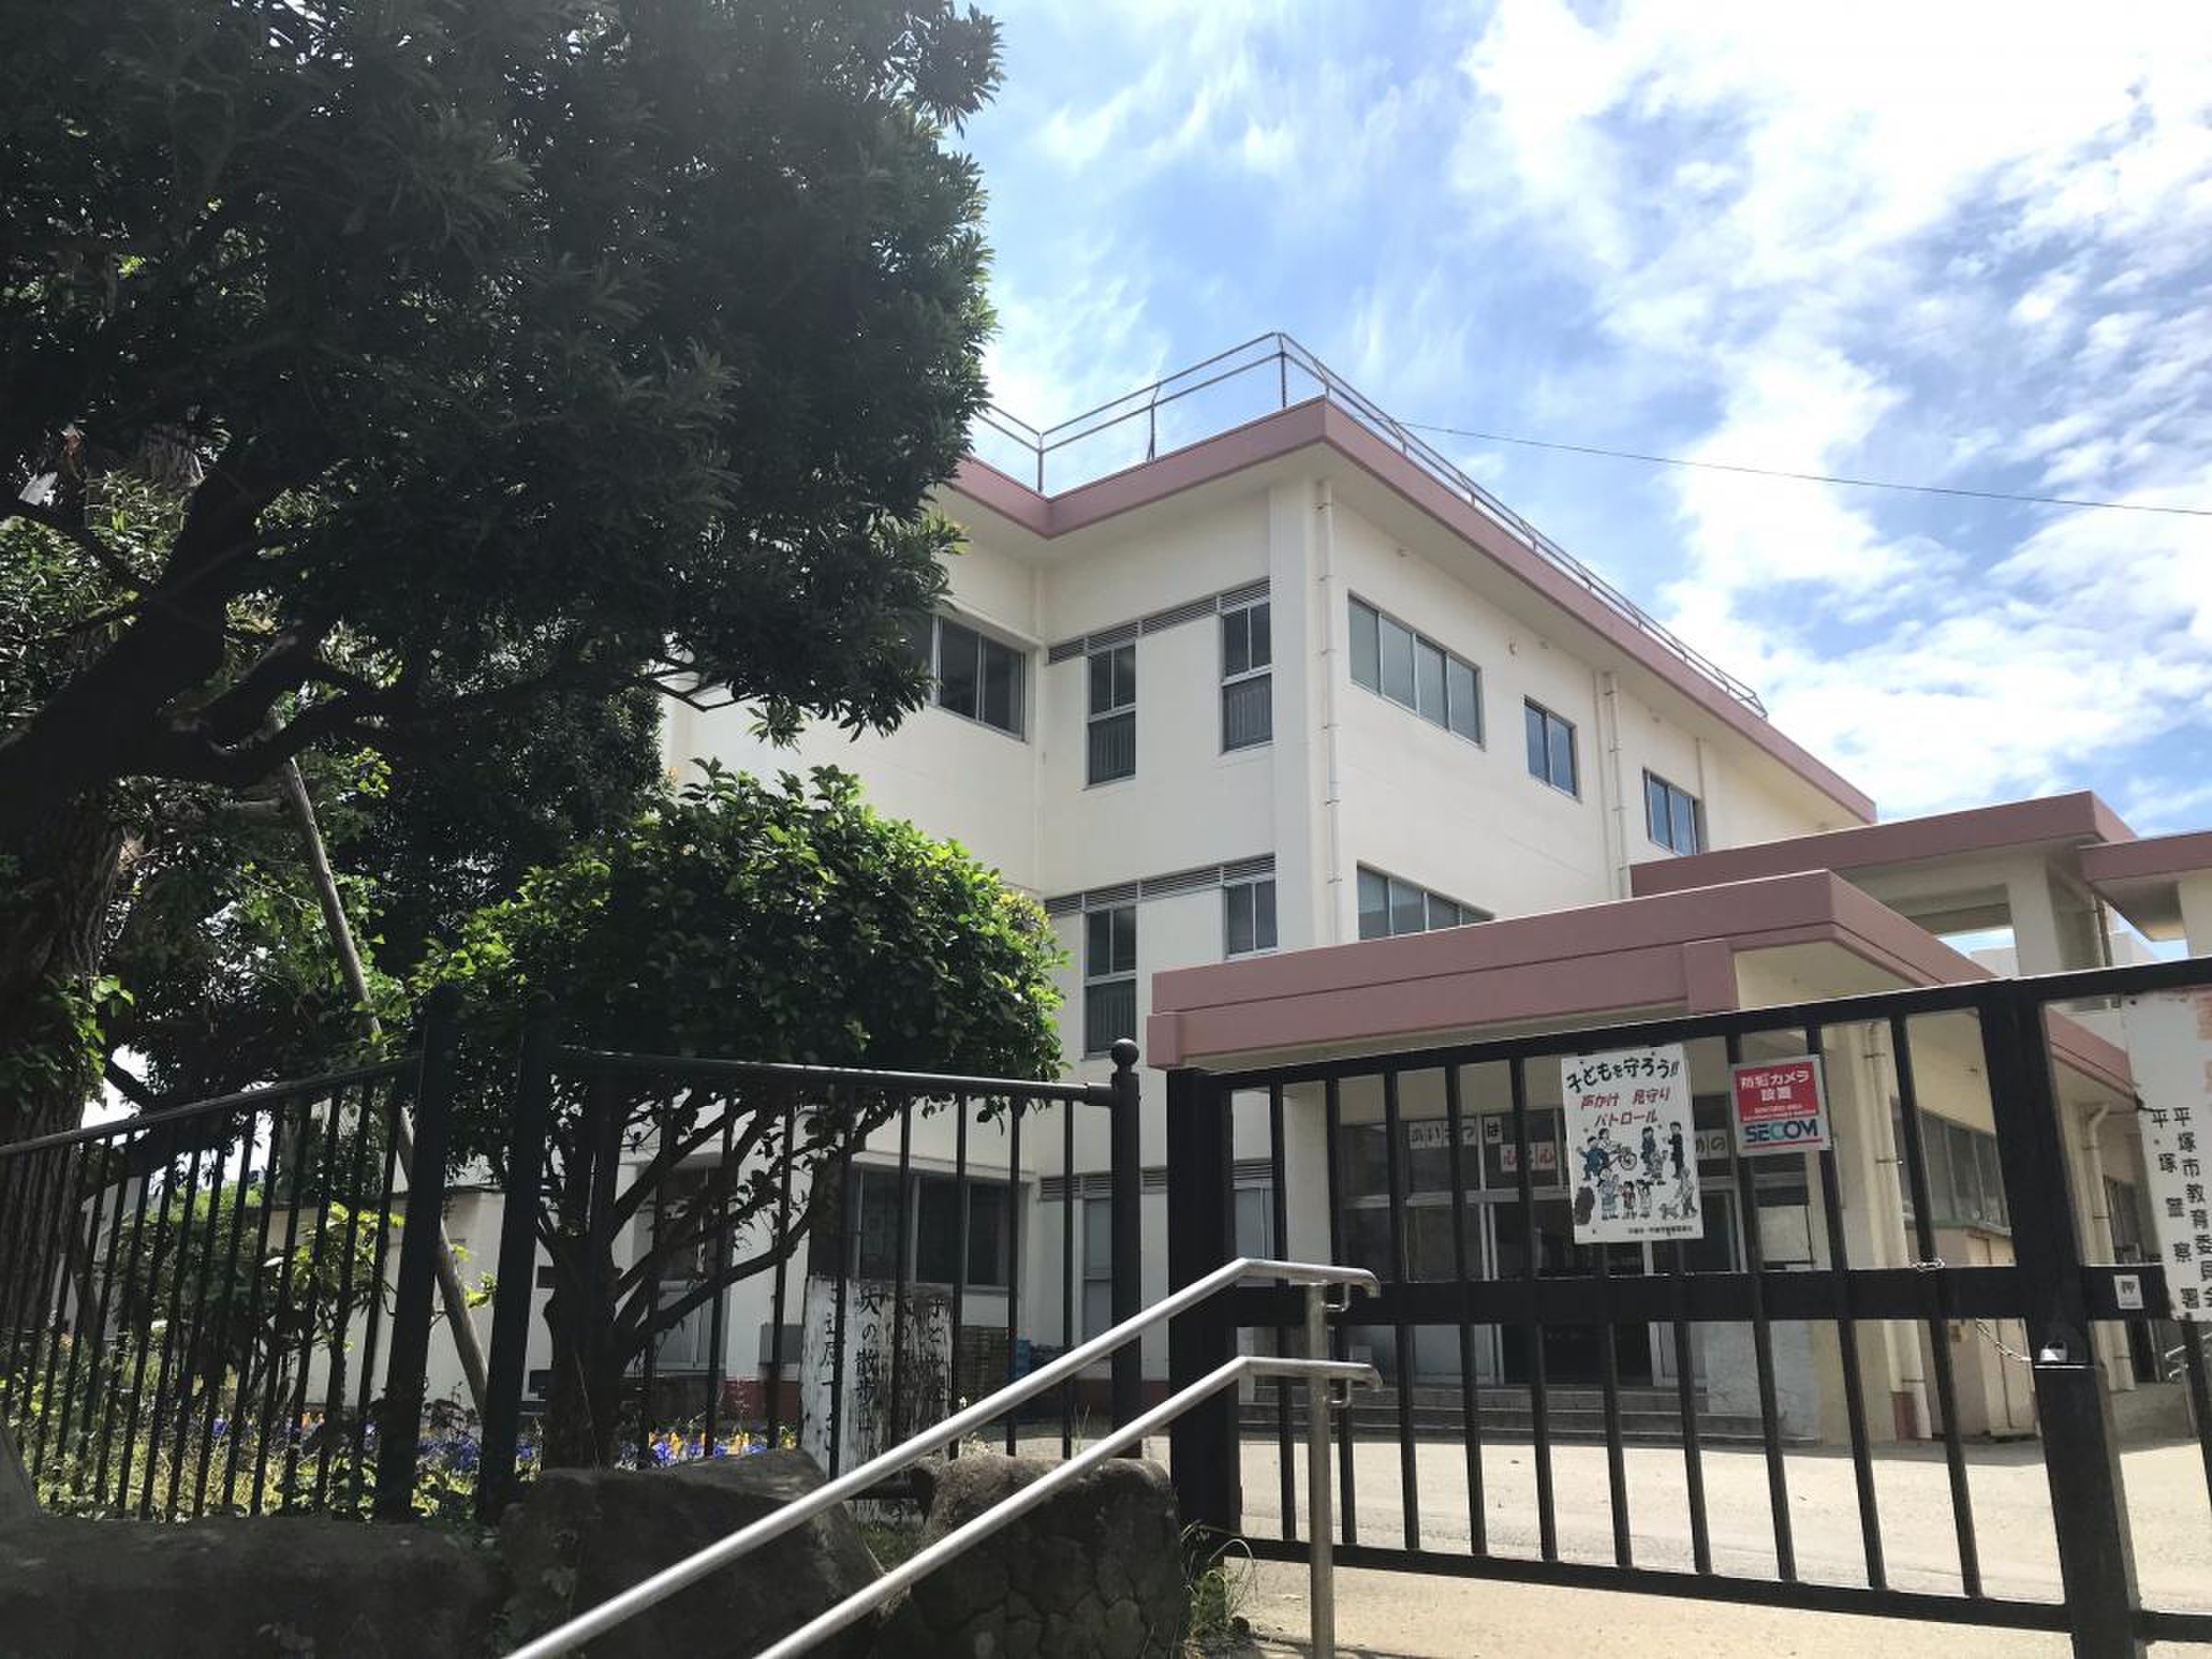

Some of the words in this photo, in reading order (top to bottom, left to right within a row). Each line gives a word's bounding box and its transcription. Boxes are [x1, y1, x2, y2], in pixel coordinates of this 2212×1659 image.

[1741, 1070, 1810, 1089] 防犯カメラ
[1581, 1092, 1620, 1111] 声かけ
[1633, 1087, 1671, 1105] 見守り
[1760, 1086, 1793, 1102] 設置
[1745, 1119, 1818, 1142] SECOM
